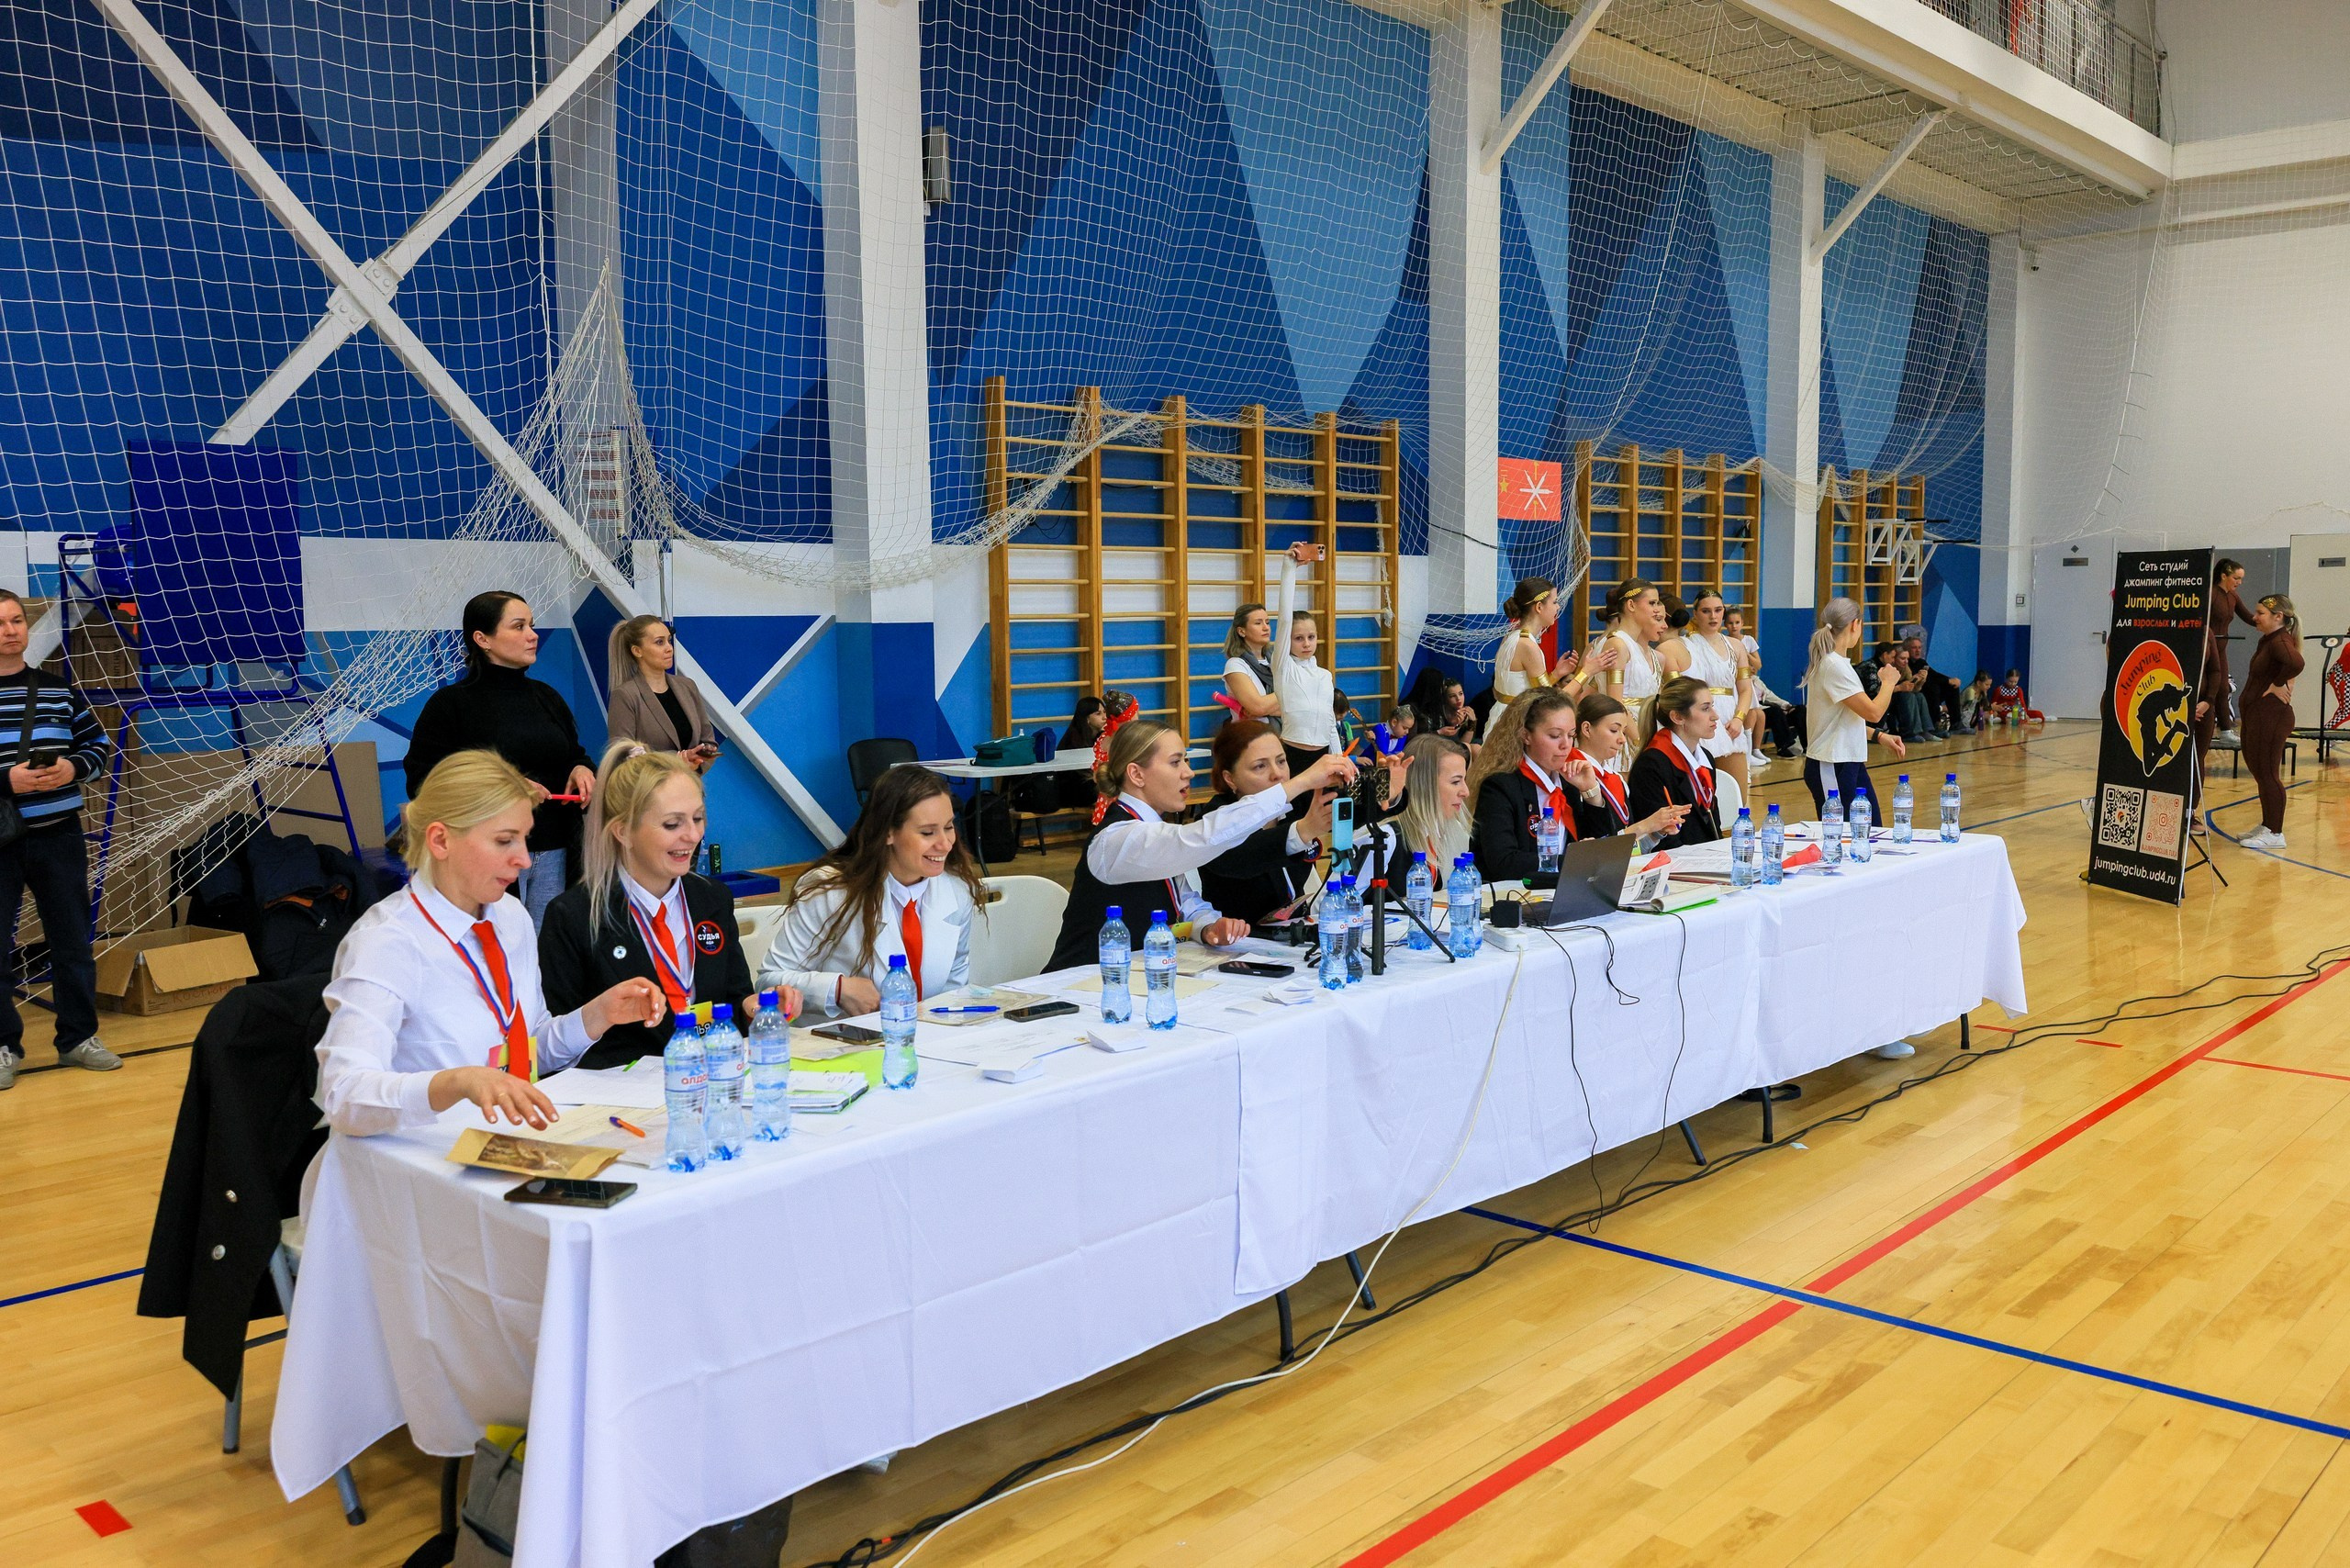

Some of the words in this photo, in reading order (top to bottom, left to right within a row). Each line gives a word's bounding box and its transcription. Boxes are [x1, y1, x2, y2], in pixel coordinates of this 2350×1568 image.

[2139, 561, 2158, 572] Сеть
[2159, 559, 2189, 573] студий
[2123, 577, 2163, 588] джампинг
[2164, 576, 2203, 588] фитнеса
[2124, 593, 2170, 612] Jumping
[2172, 593, 2200, 609] Club
[2116, 619, 2132, 628] для
[2133, 618, 2169, 629] взрослых
[2171, 619, 2177, 627] и
[2120, 648, 2162, 696] Jumping
[2136, 674, 2156, 697] Club
[2094, 856, 2176, 885] jumpingclub.ud4.ru
[698, 933, 720, 941] СУДЬЯ
